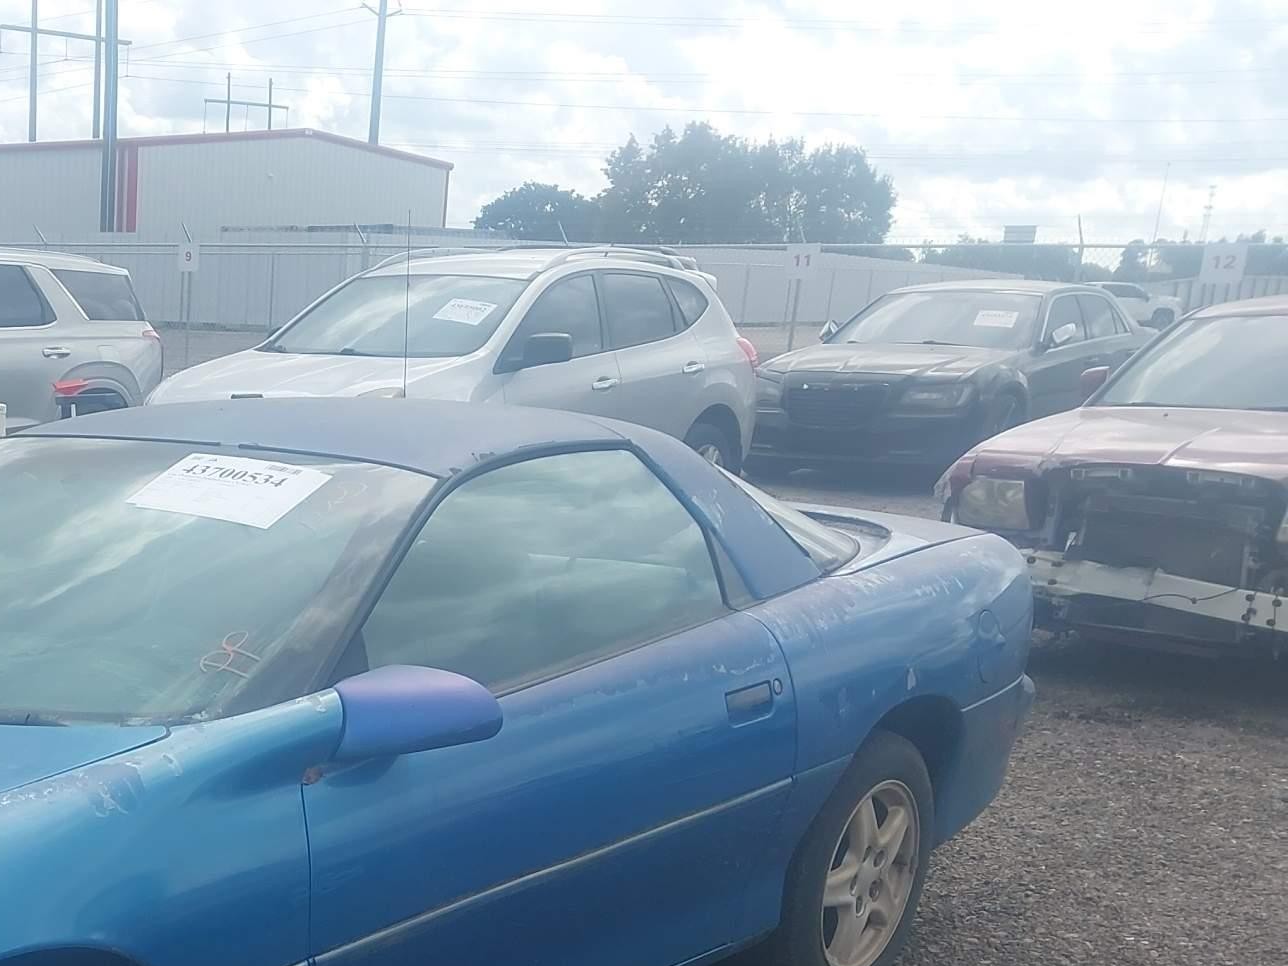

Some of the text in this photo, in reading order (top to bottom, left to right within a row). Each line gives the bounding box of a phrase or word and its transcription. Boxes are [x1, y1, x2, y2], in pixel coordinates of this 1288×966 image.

[185, 251, 192, 262] 9
[793, 254, 810, 266] 11
[1212, 255, 1237, 269] 12
[183, 464, 288, 487] 43700534
